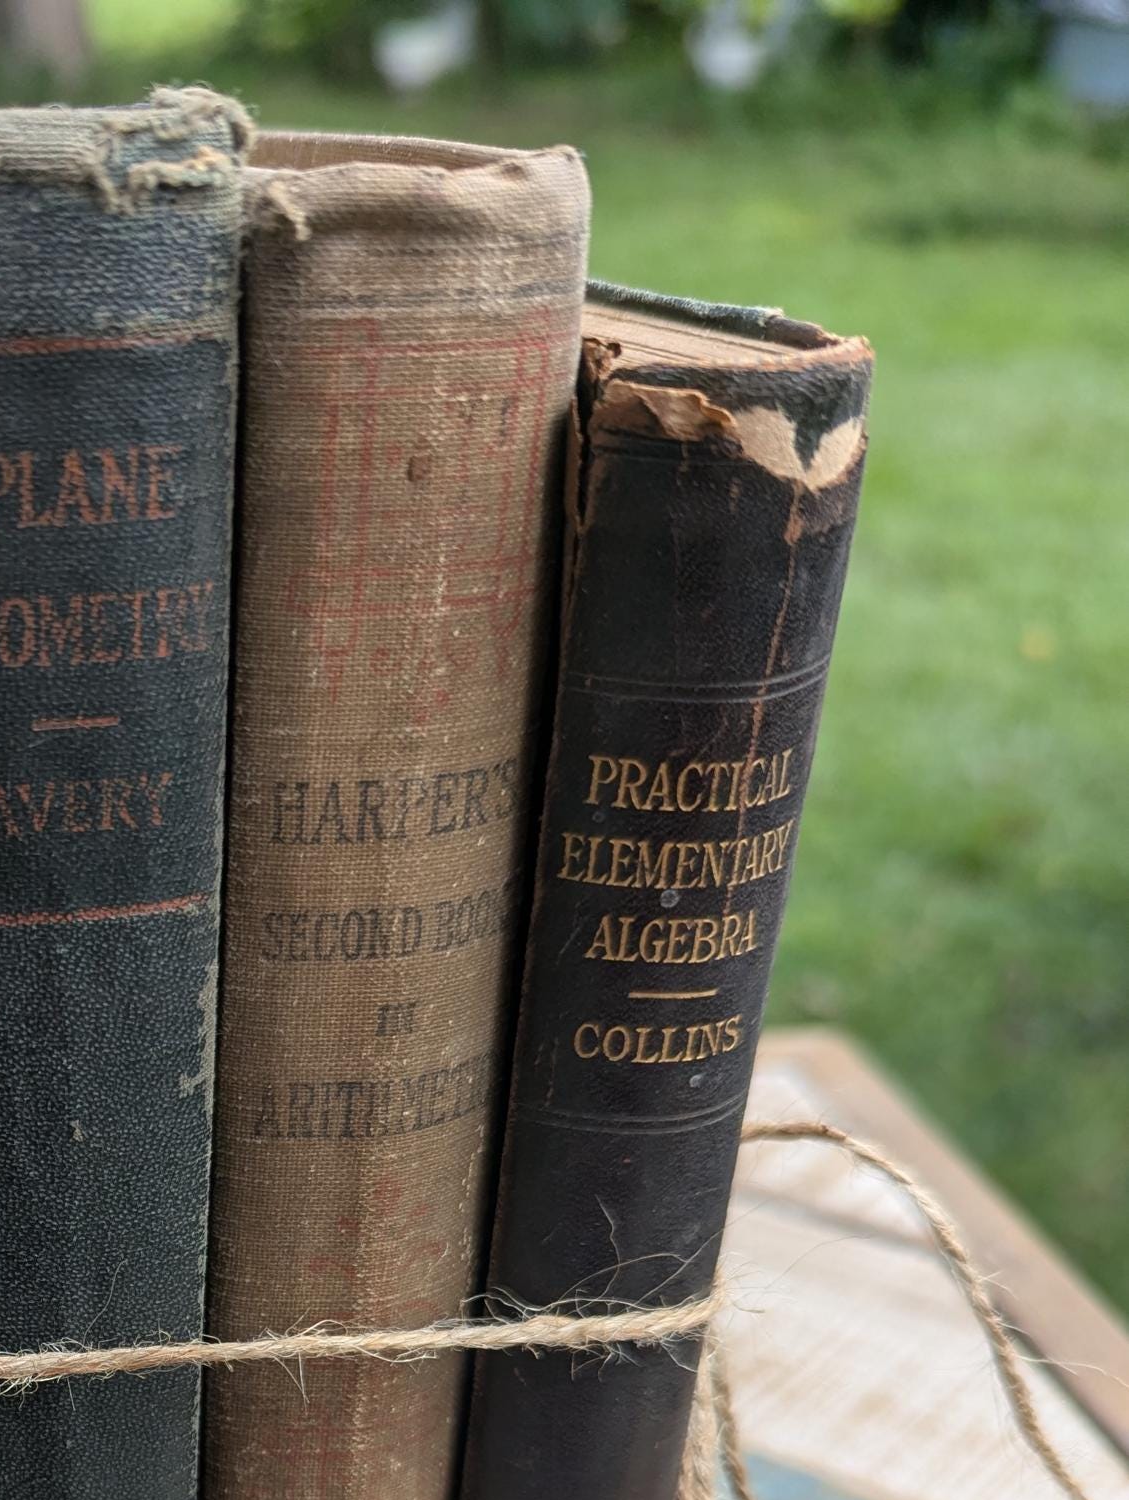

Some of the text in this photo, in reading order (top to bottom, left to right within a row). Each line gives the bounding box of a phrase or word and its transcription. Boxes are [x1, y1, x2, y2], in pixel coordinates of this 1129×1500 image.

[269, 757, 519, 846] HARPER'S
[583, 749, 794, 813] PRACTICAL
[557, 819, 795, 889] ELEMENTARY
[261, 906, 424, 963] SECOND
[584, 910, 758, 964] ALGEBRA
[374, 1002, 417, 1037] IN
[573, 1014, 743, 1064] COLLINS
